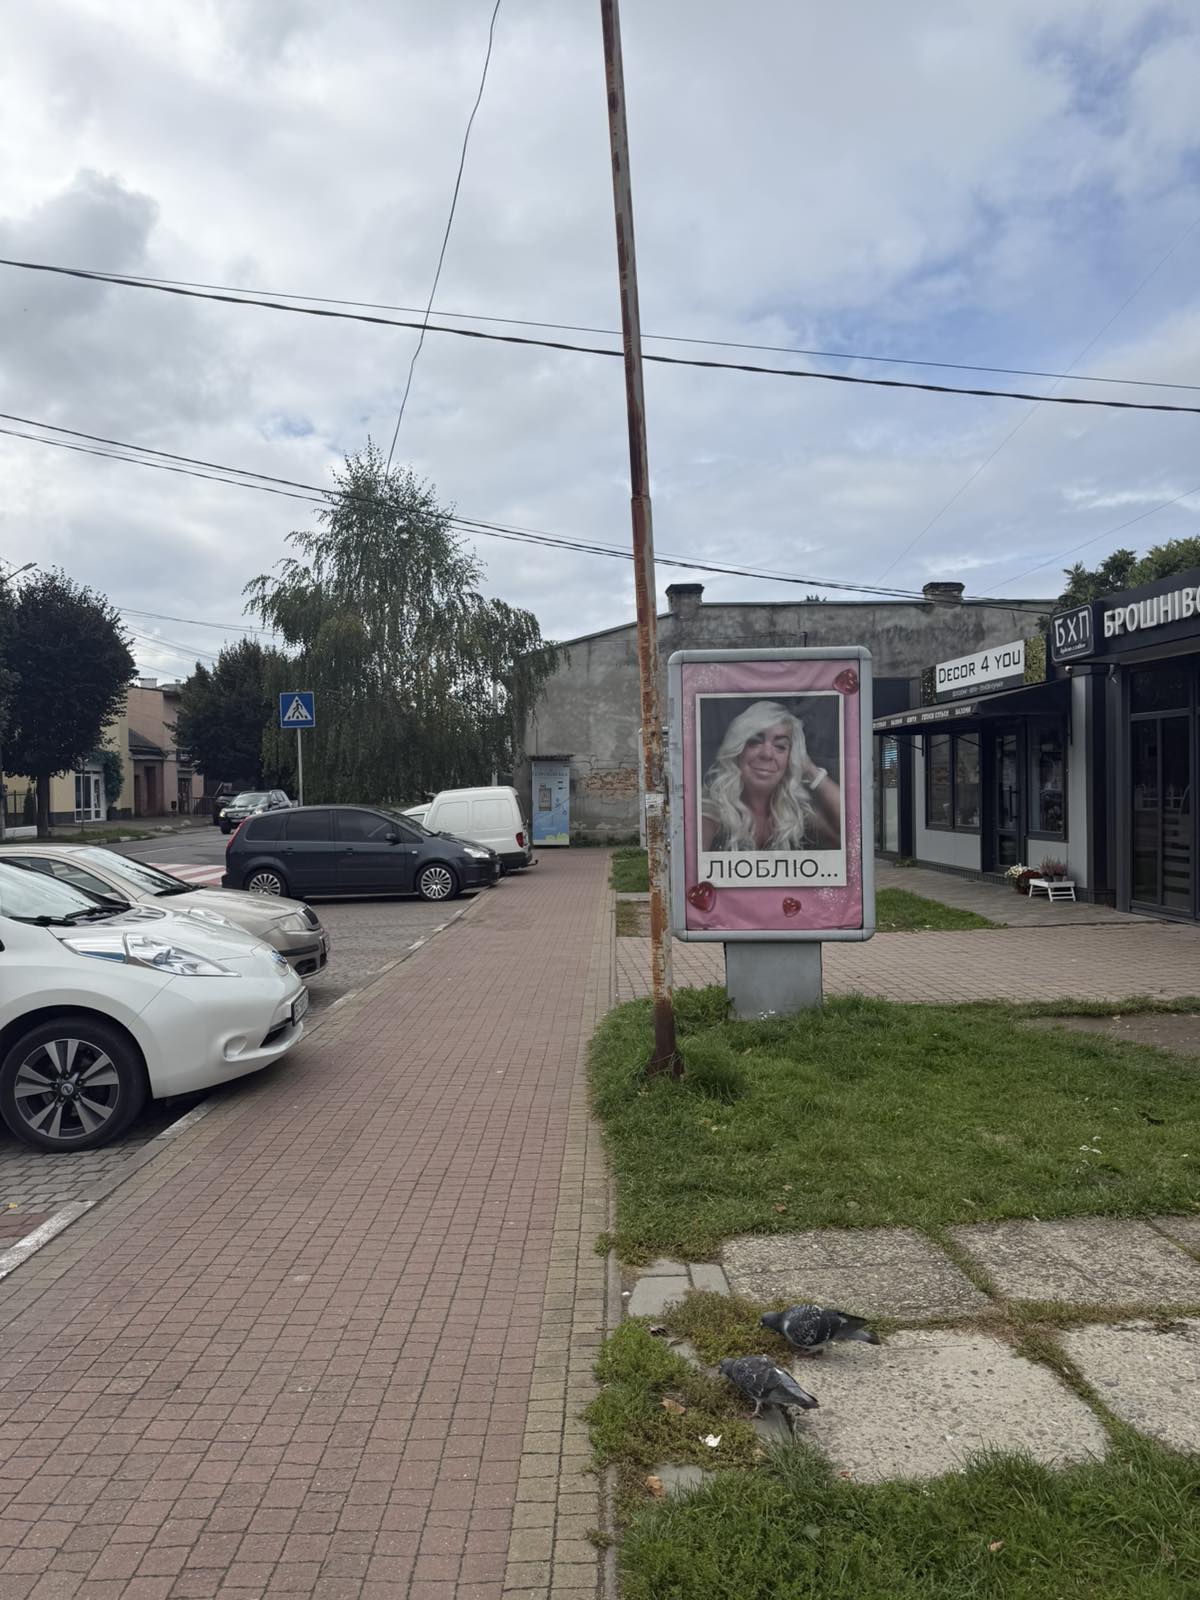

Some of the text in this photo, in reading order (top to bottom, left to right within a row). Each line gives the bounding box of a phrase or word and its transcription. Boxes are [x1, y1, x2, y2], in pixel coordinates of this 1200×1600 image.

[1054, 610, 1090, 648] БХП
[981, 655, 990, 672] 4
[994, 649, 1021, 670] YOU
[706, 859, 839, 879] ЛЮБЛЮ...
